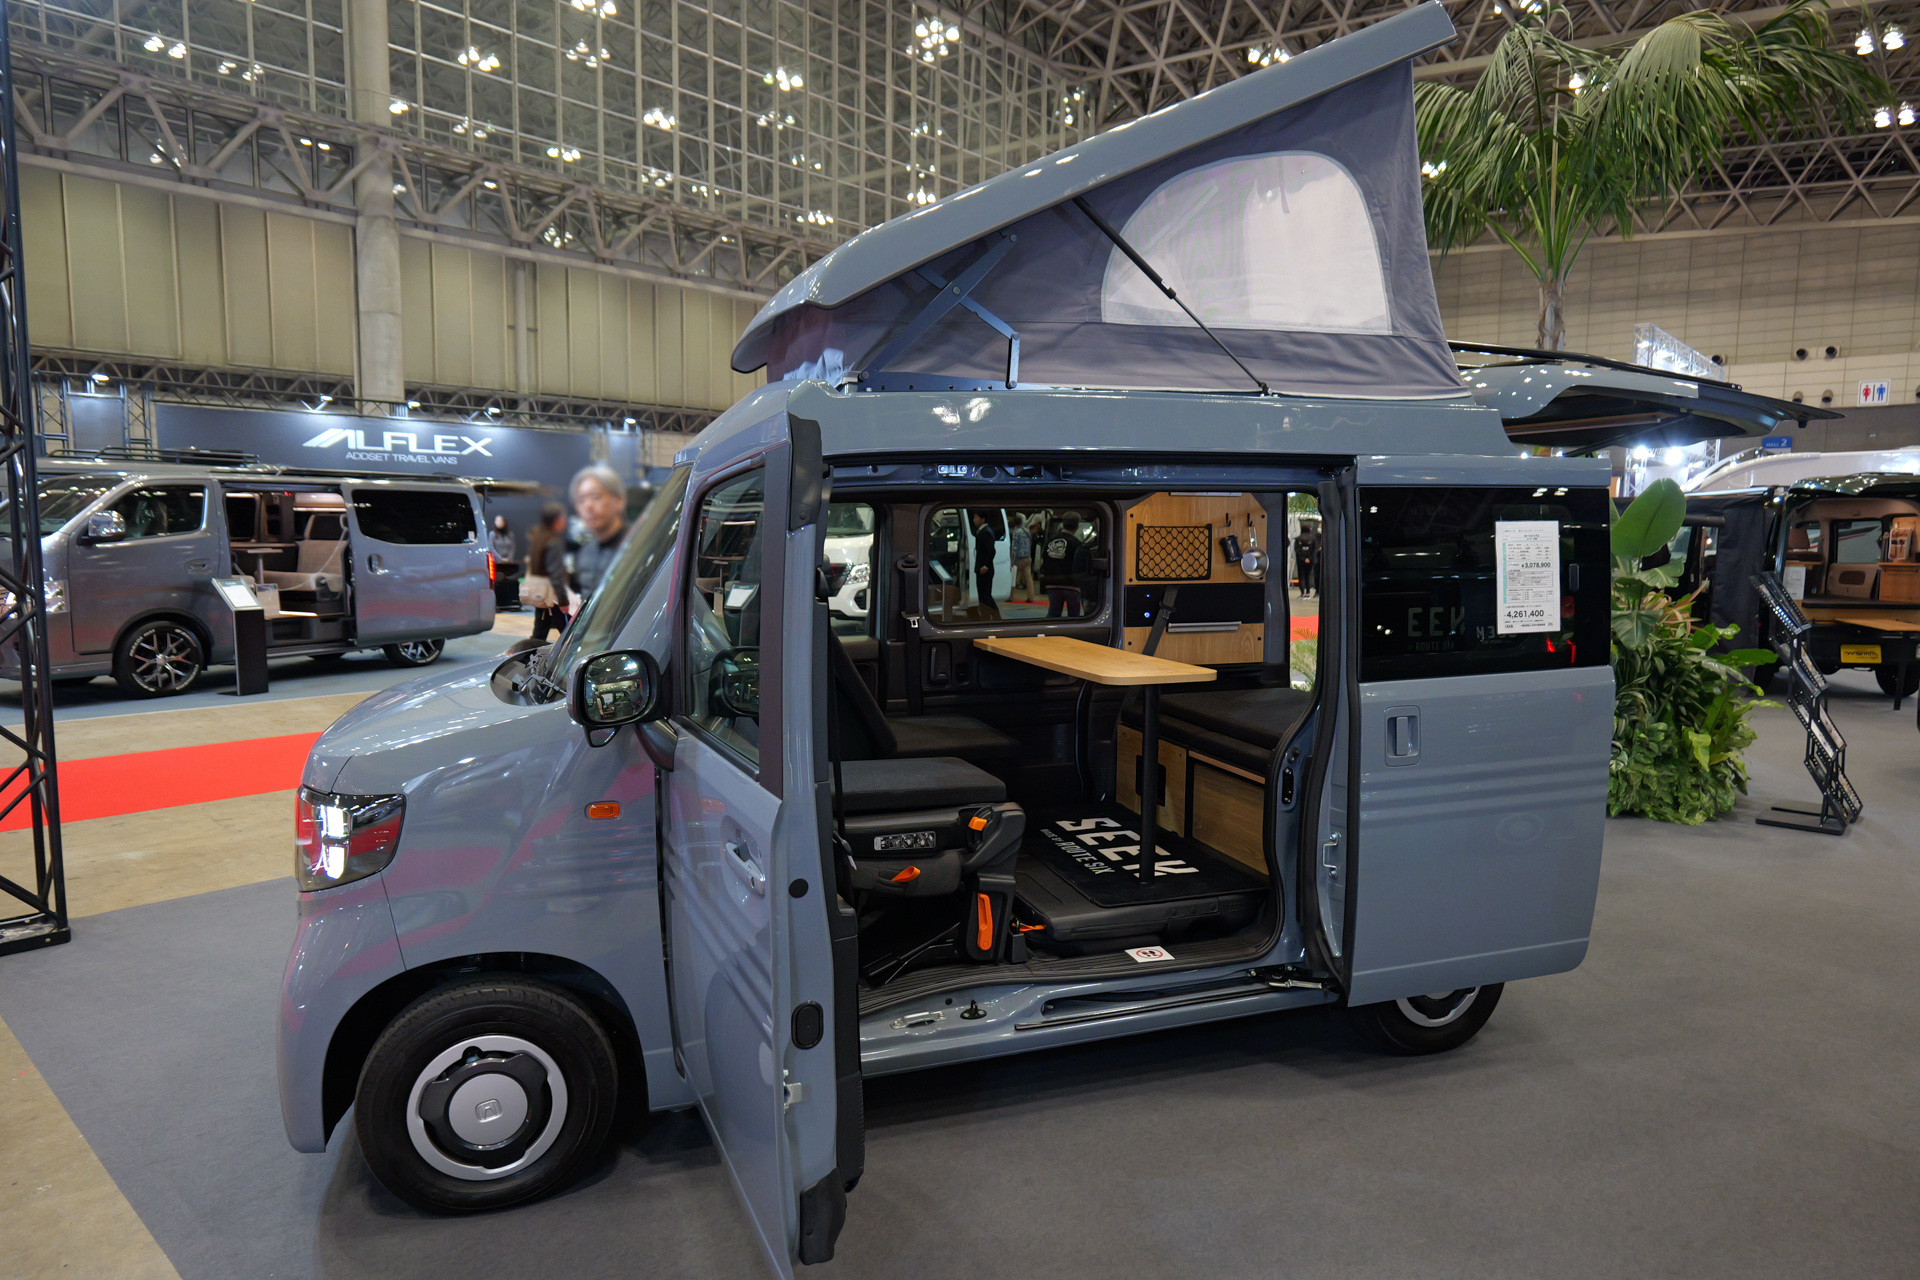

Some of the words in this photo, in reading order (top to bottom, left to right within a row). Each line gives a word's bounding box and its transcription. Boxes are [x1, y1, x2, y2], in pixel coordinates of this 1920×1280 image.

[1780, 438, 1788, 447] 2
[345, 451, 390, 462] ADDSET
[391, 453, 431, 464] TRAVEL
[432, 455, 458, 465] VANS
[1415, 641, 1440, 652] ROUTE
[1055, 841, 1098, 863] ROUTE
[1084, 861, 1116, 875] SIX
